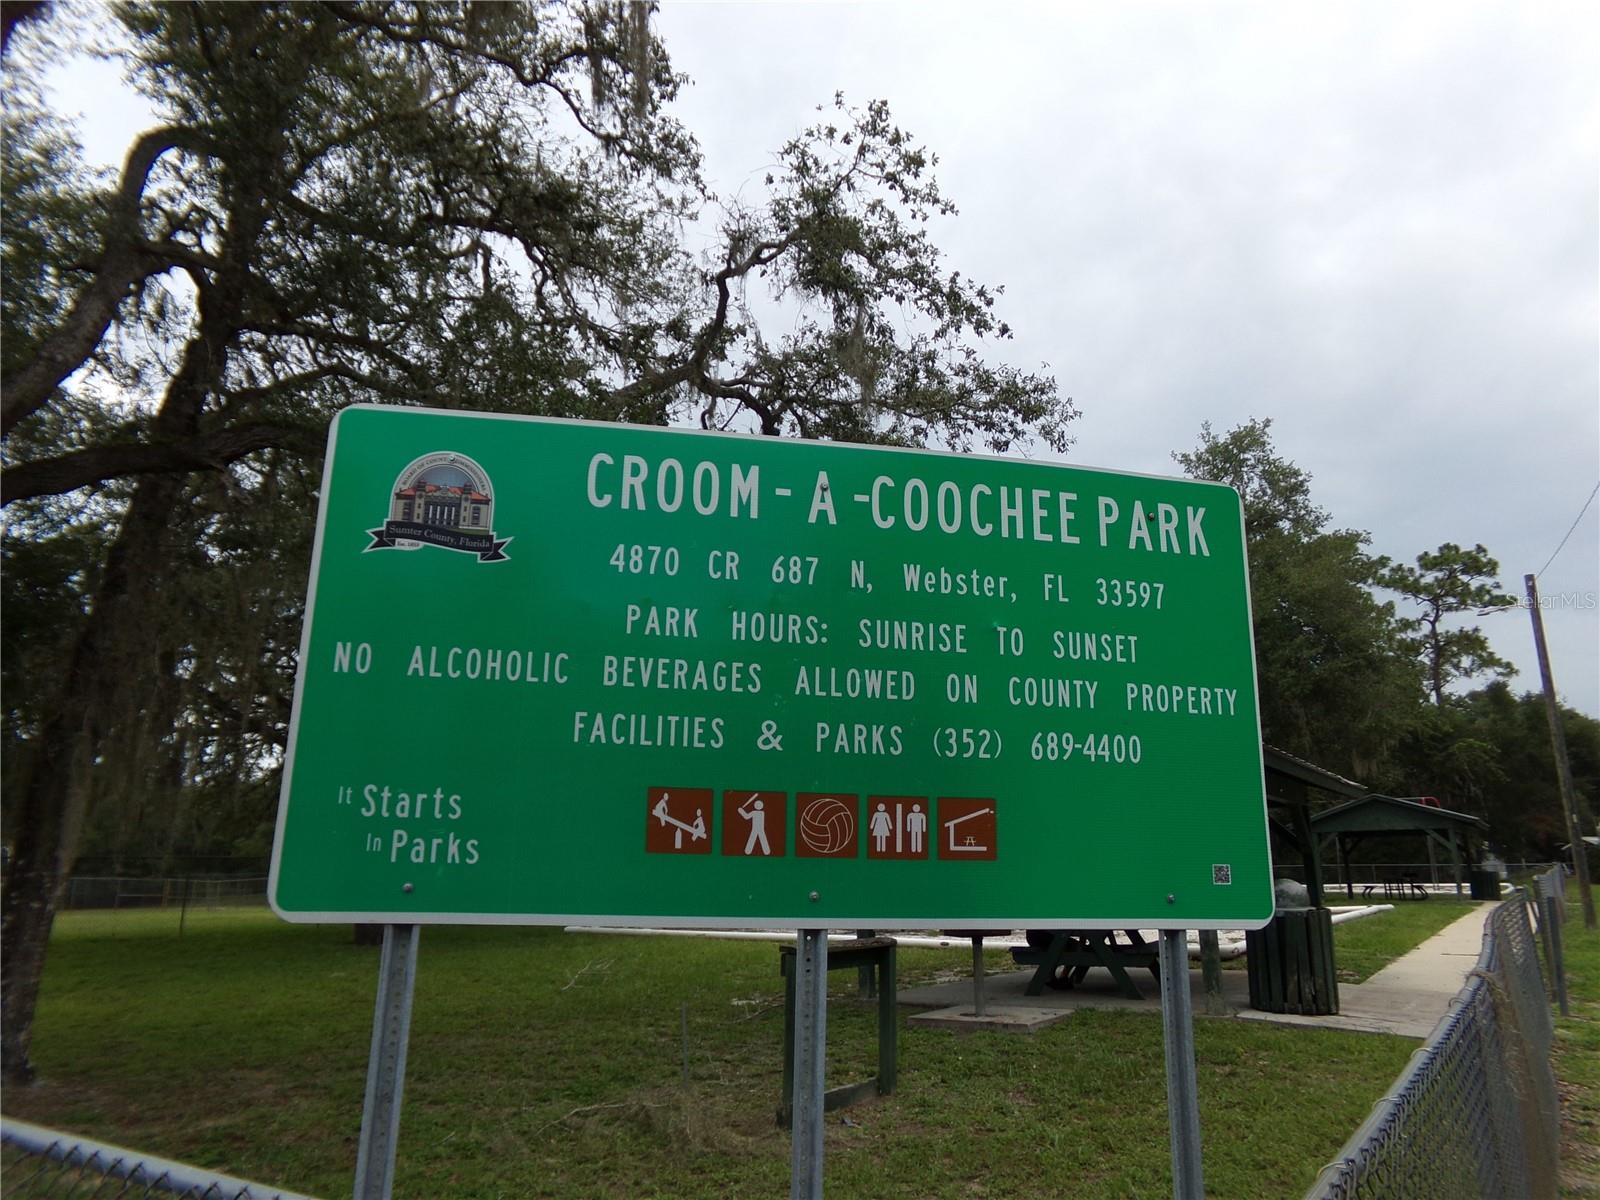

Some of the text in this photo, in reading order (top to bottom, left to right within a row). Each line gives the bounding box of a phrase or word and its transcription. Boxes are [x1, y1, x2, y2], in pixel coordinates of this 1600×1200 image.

[587, 452, 760, 519] CROOM
[1097, 495, 1211, 557] PARK
[609, 543, 1164, 611] 4870 CR 687 N, Webster, FL 33597
[626, 604, 1138, 664] PARK HOURS: SUNRISE TO SUNSET
[333, 641, 1237, 717] NO ALCOHOLIC BEVERAGES ALLOWED ON COUNTY PROPERTY
[573, 711, 1142, 764] FACILITIES & PARKS (352) 689-4400
[338, 784, 461, 819] It Starts
[366, 829, 479, 865] In Parks
